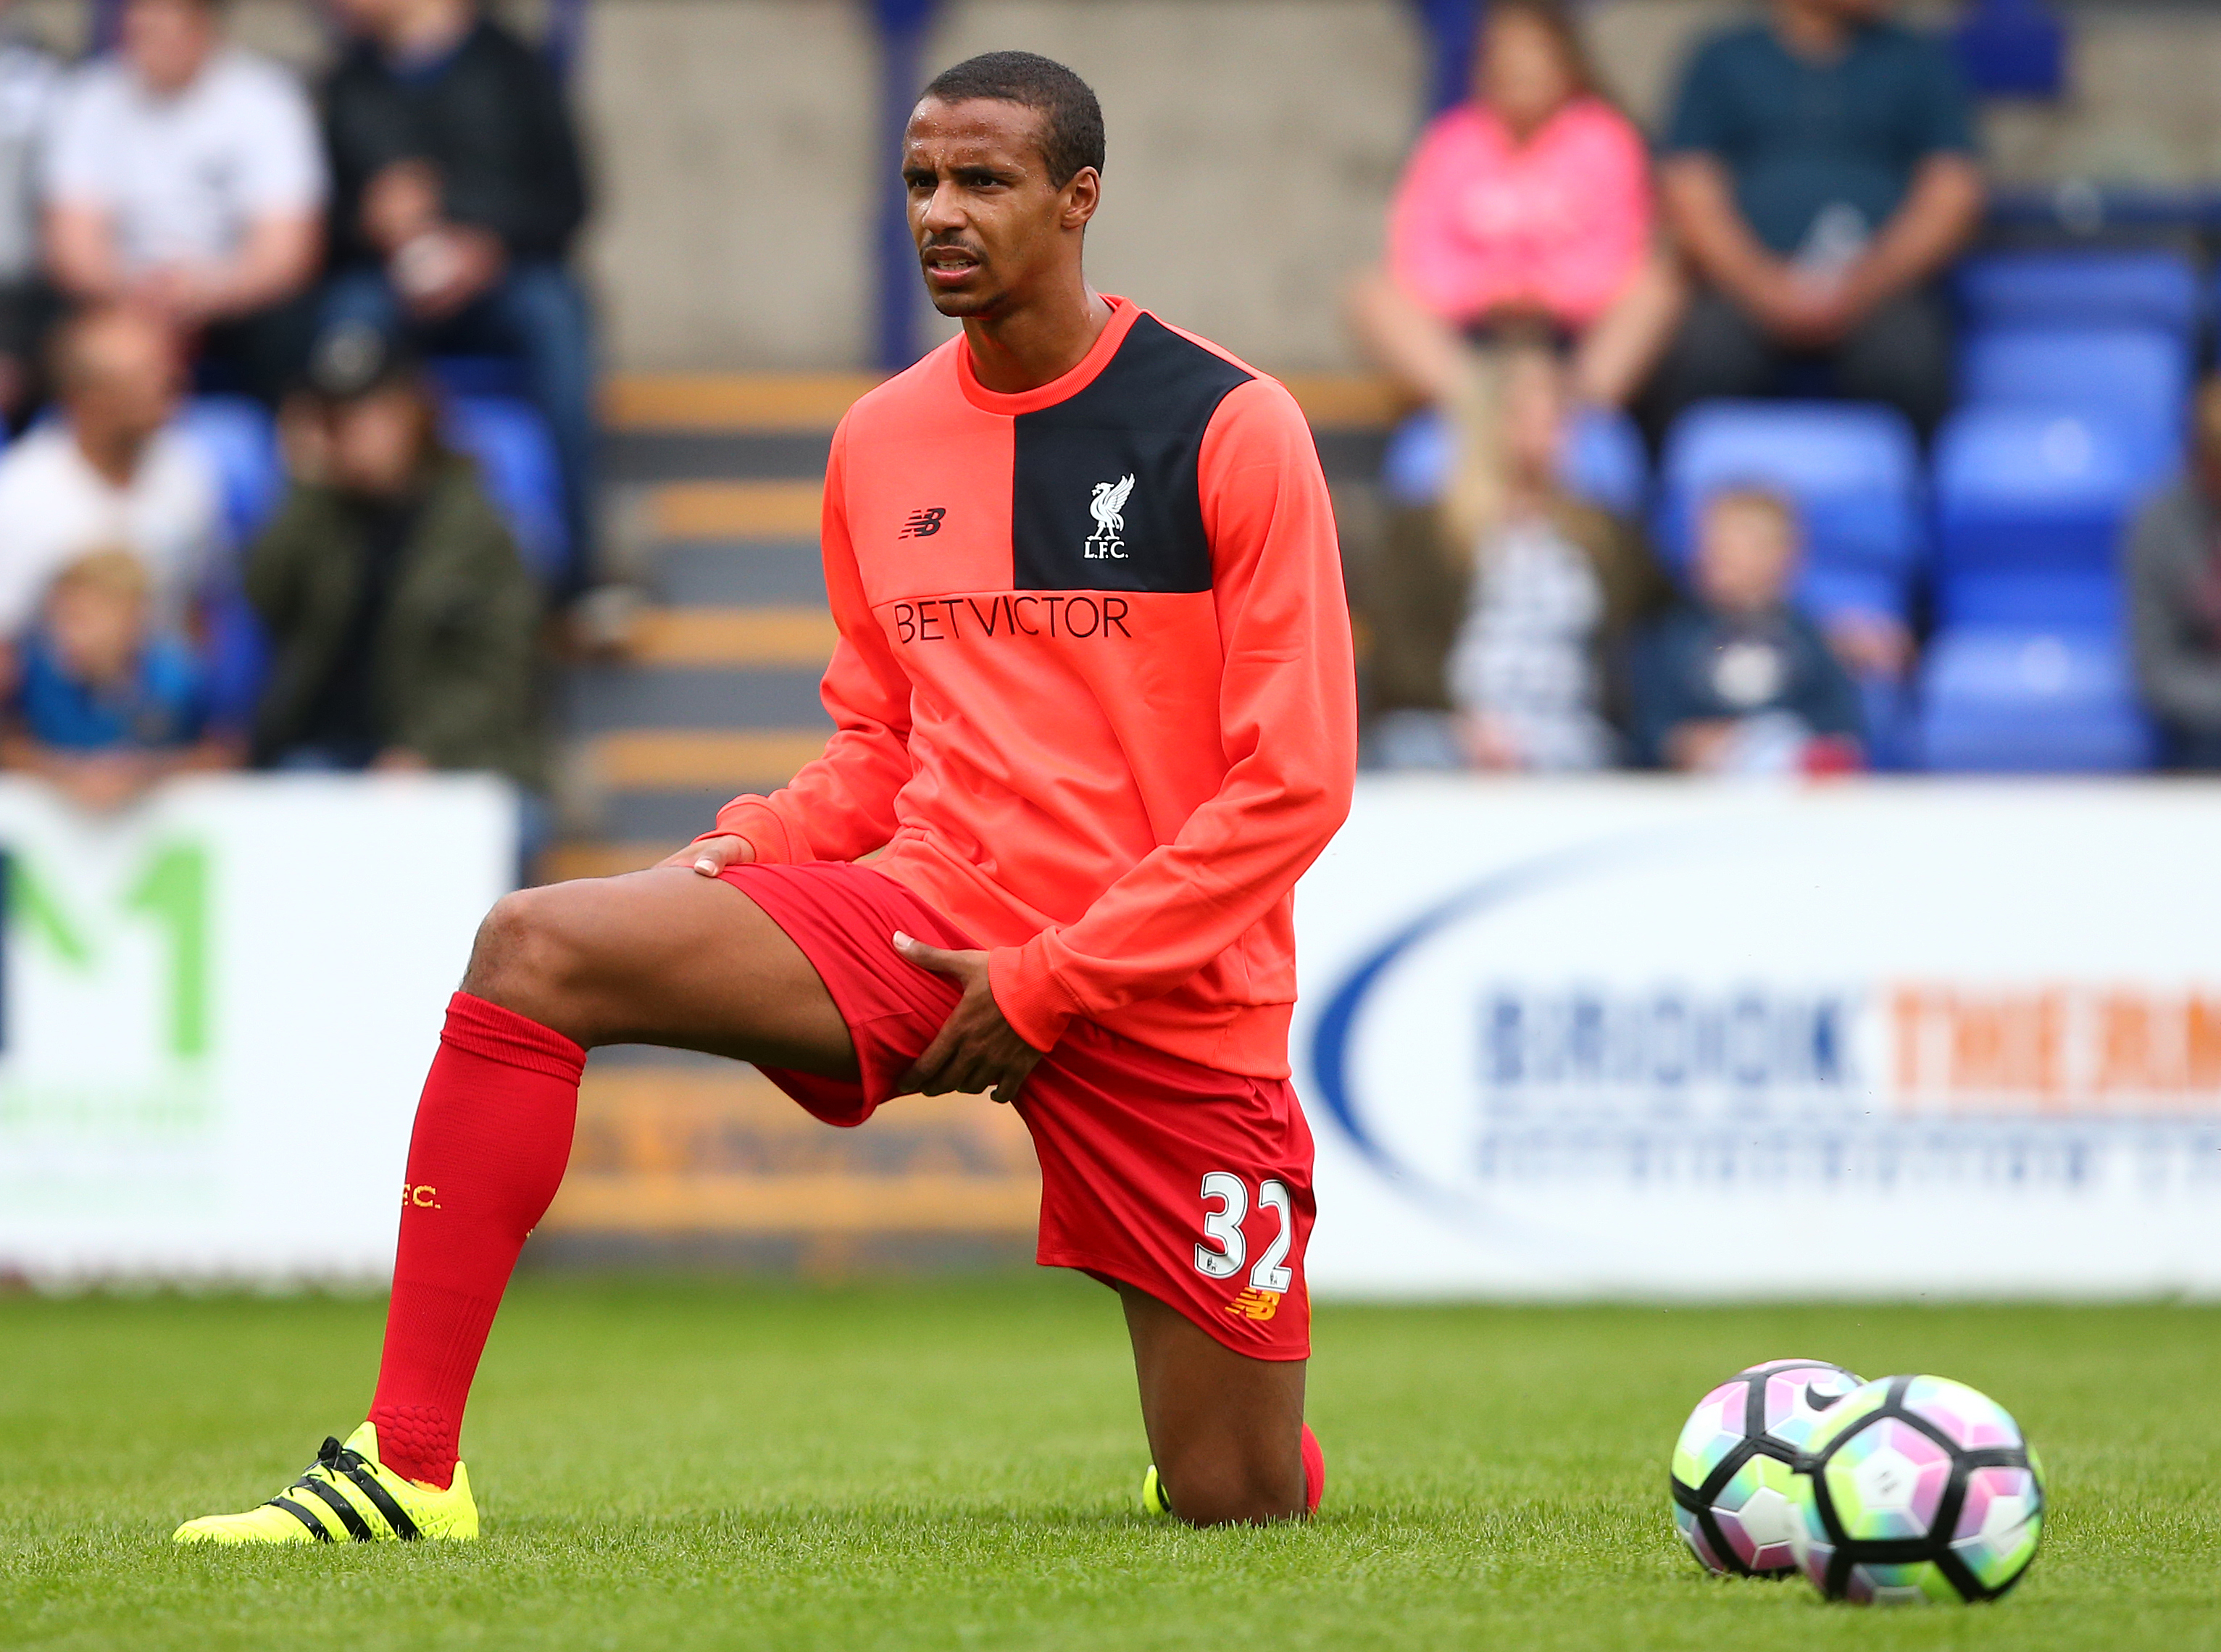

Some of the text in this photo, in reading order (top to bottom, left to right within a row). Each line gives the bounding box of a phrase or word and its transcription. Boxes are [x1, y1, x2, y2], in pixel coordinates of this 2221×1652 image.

[1083, 541, 1129, 559] L.F.C.
[893, 596, 1132, 643] BETVICTOR
[1195, 1171, 1293, 1293] 32
